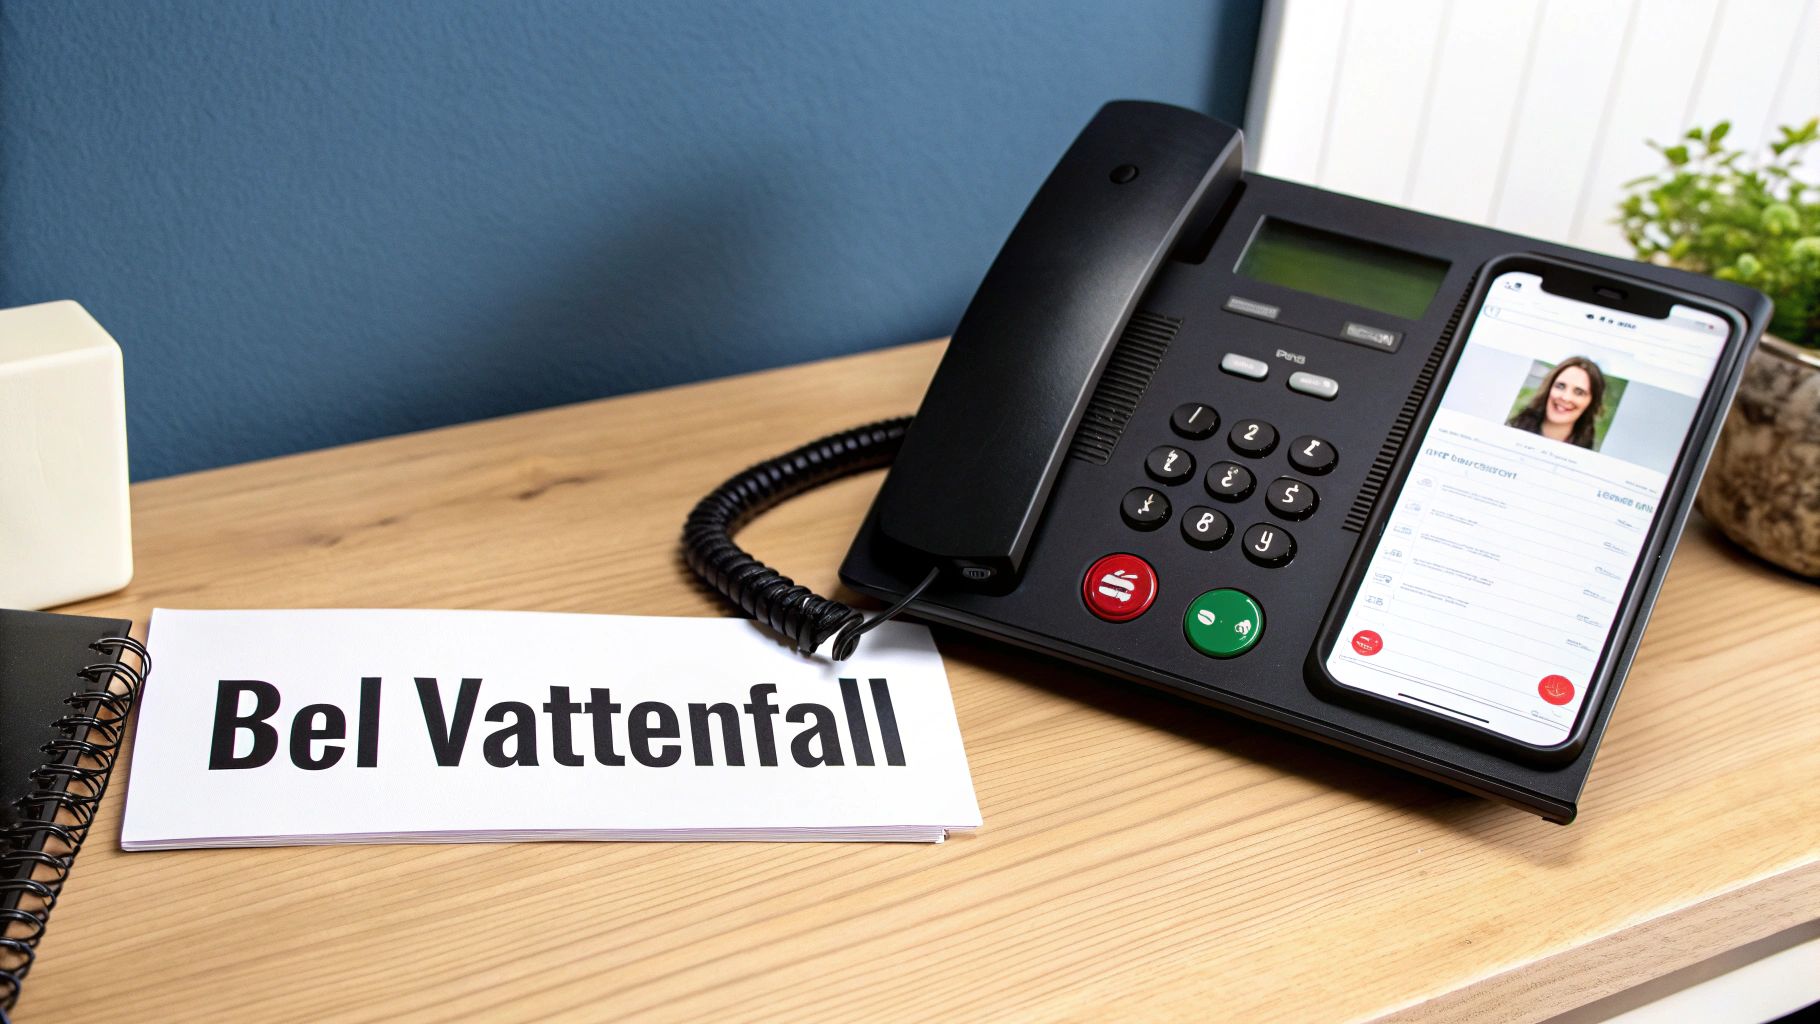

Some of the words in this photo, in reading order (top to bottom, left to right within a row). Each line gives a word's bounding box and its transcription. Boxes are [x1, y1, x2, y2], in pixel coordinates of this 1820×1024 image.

[1243, 424, 1260, 441] 2
[1196, 512, 1215, 533] 8
[208, 677, 382, 771] Bel
[413, 677, 906, 768] Vattenfall
